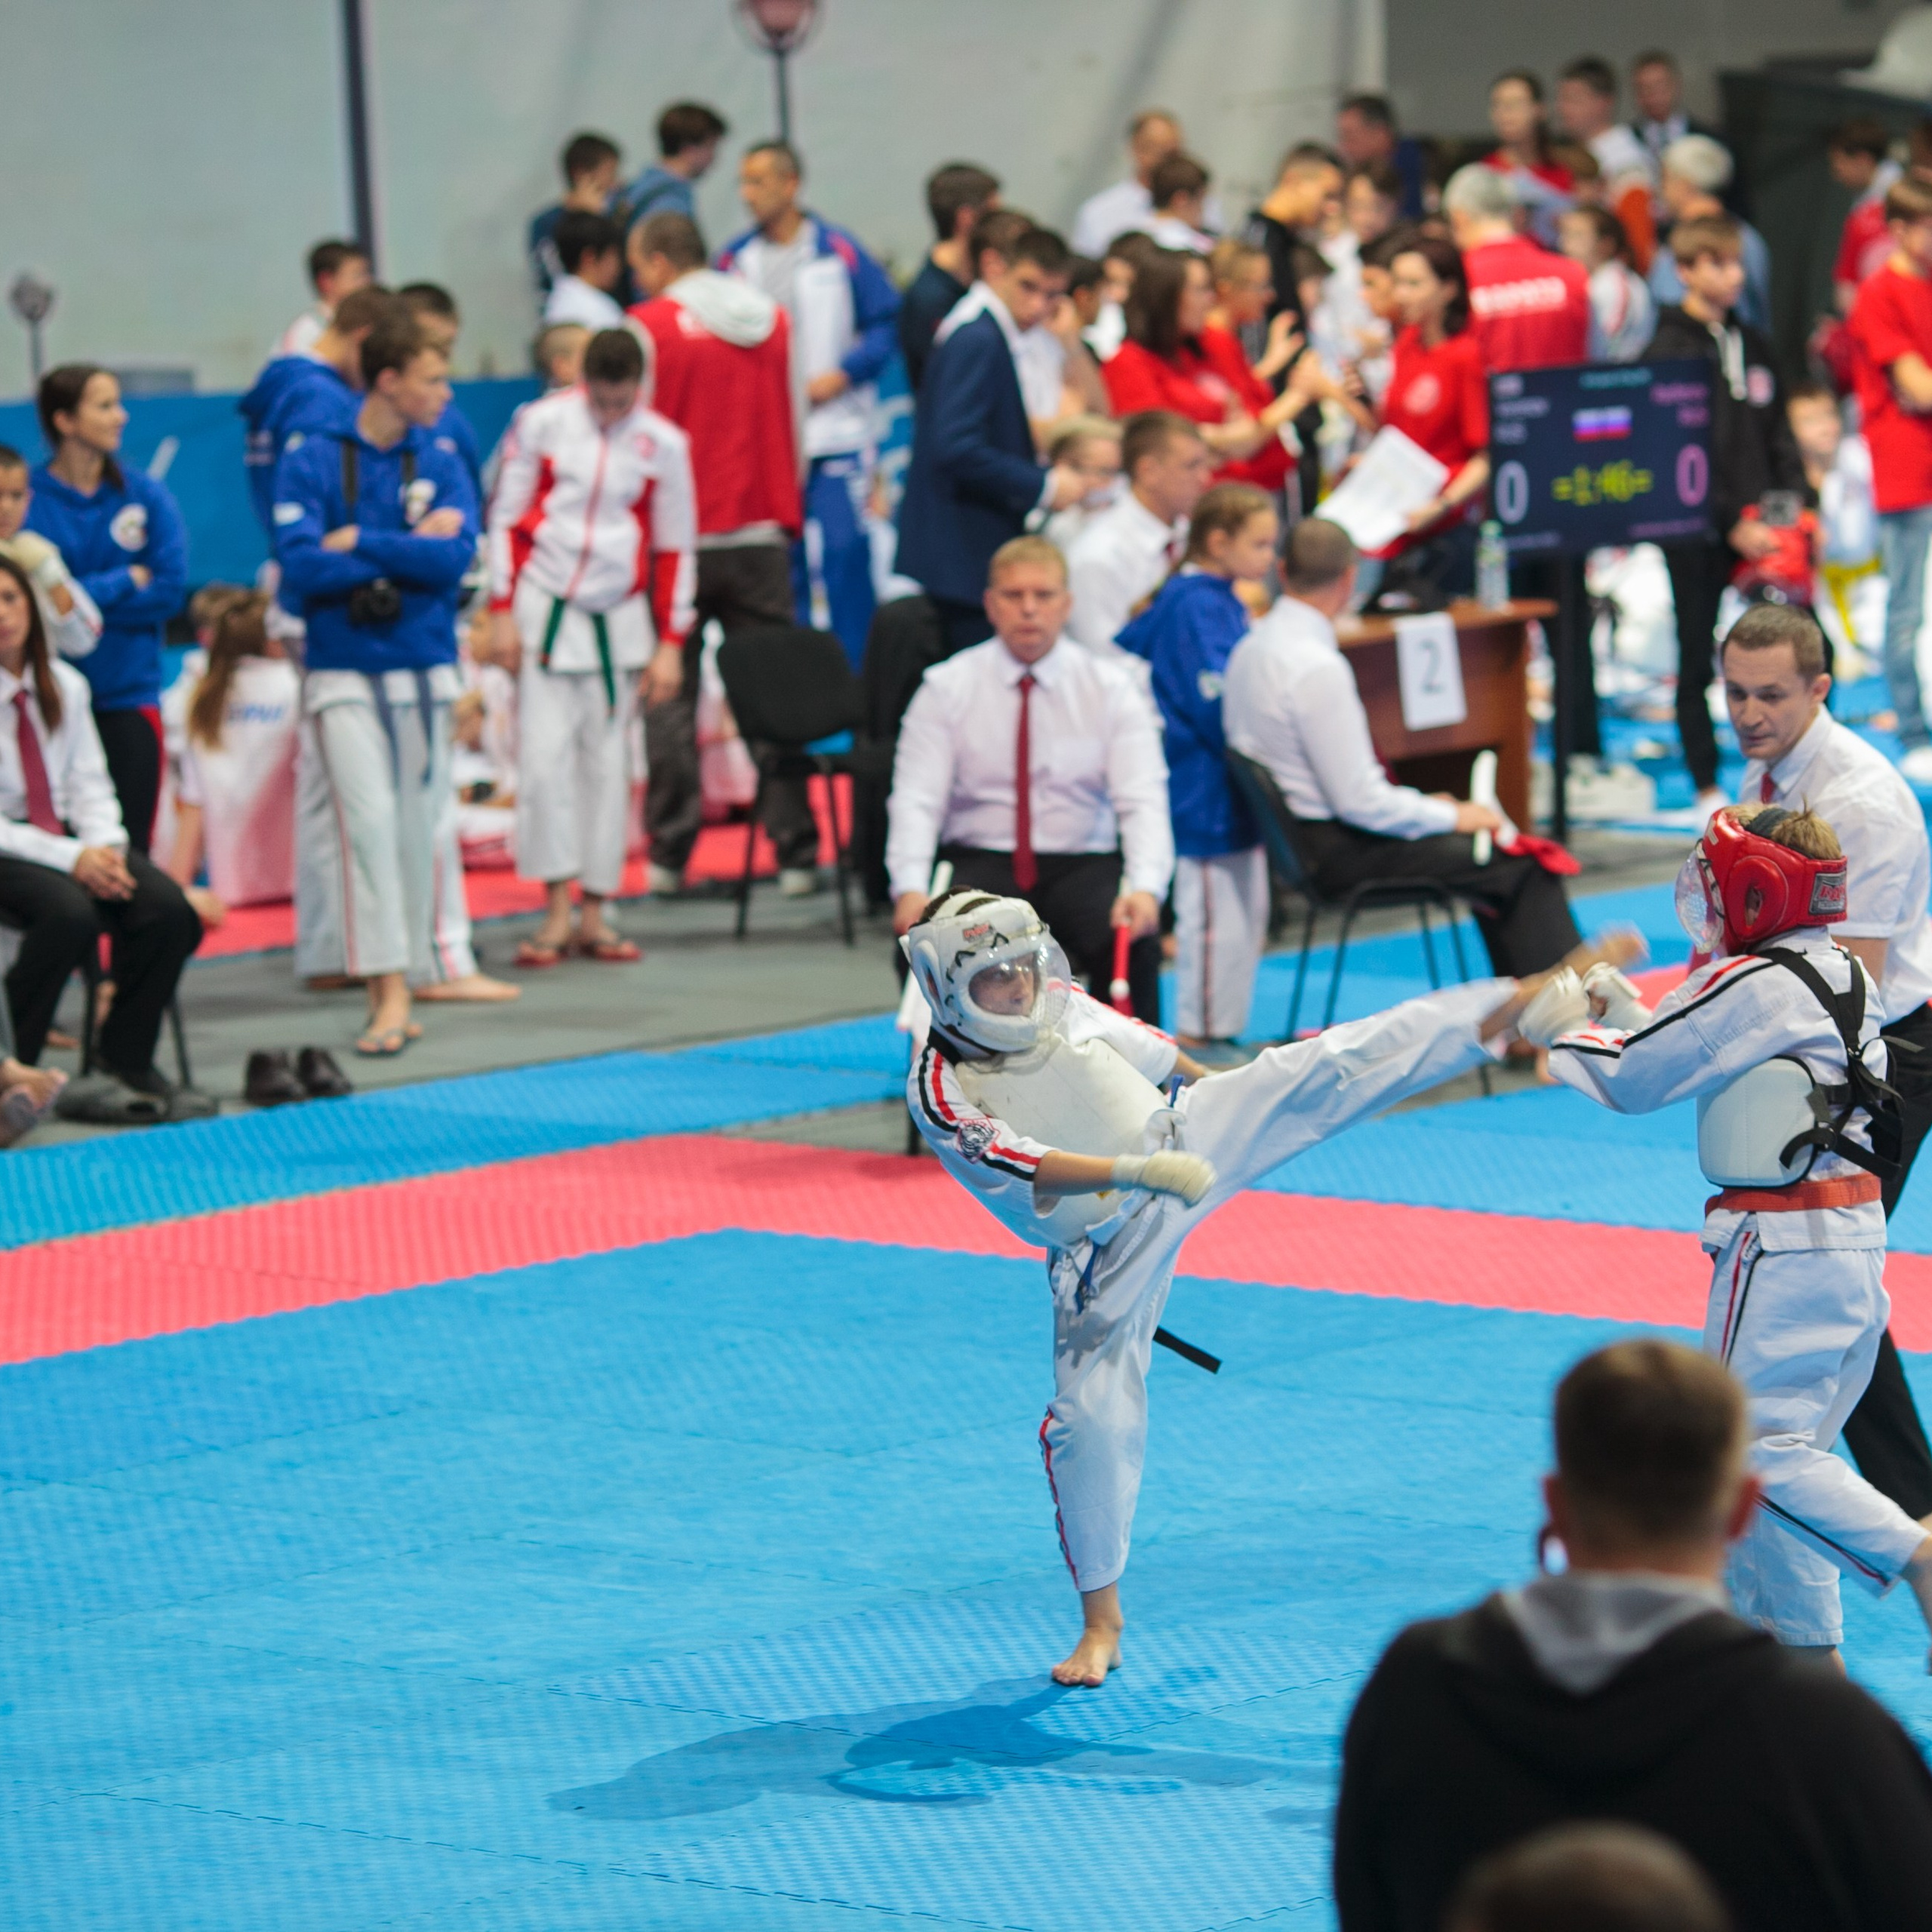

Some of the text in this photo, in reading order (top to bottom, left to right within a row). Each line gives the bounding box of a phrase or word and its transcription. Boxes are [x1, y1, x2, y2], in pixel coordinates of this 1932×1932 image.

[1496, 461, 1528, 524] 0
[1676, 445, 1708, 507] 0
[1418, 640, 1445, 695] 2
